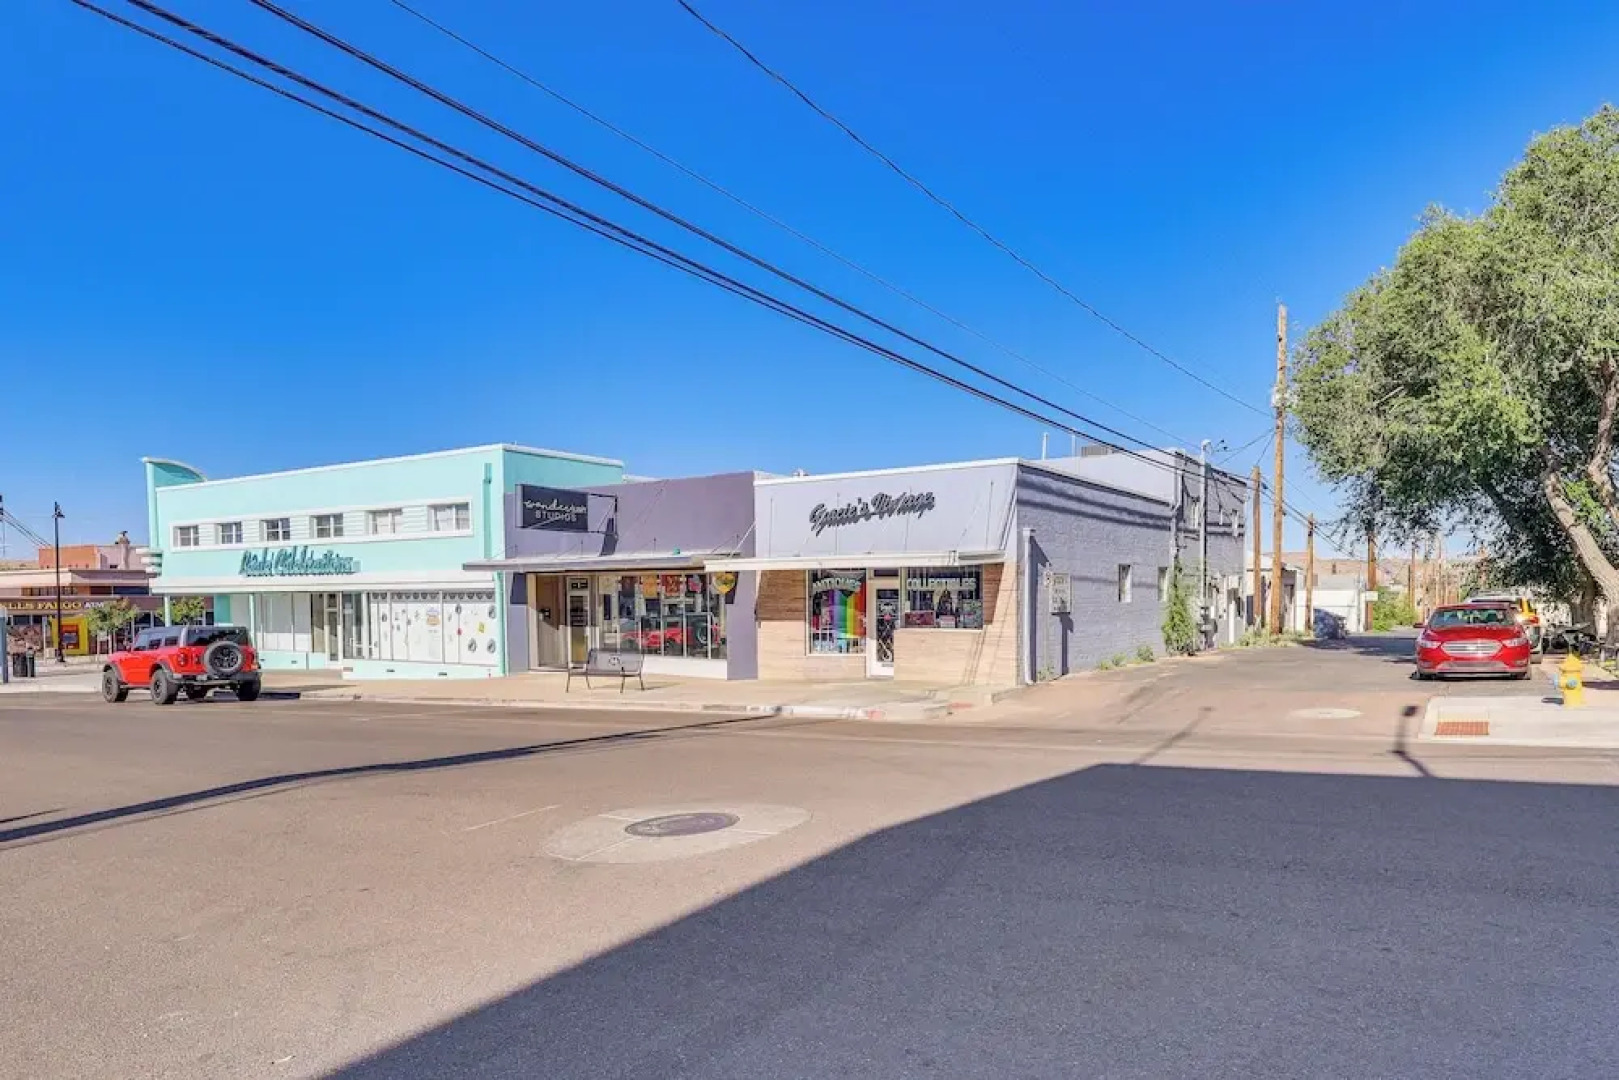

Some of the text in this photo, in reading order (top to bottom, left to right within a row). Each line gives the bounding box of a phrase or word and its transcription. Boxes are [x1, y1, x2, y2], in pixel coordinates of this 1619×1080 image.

[535, 510, 577, 522] STUDIOS
[809, 491, 935, 537] Gracie's Vintage
[812, 576, 862, 592] ANTIQUES
[906, 577, 977, 590] COLLECTIBLES
